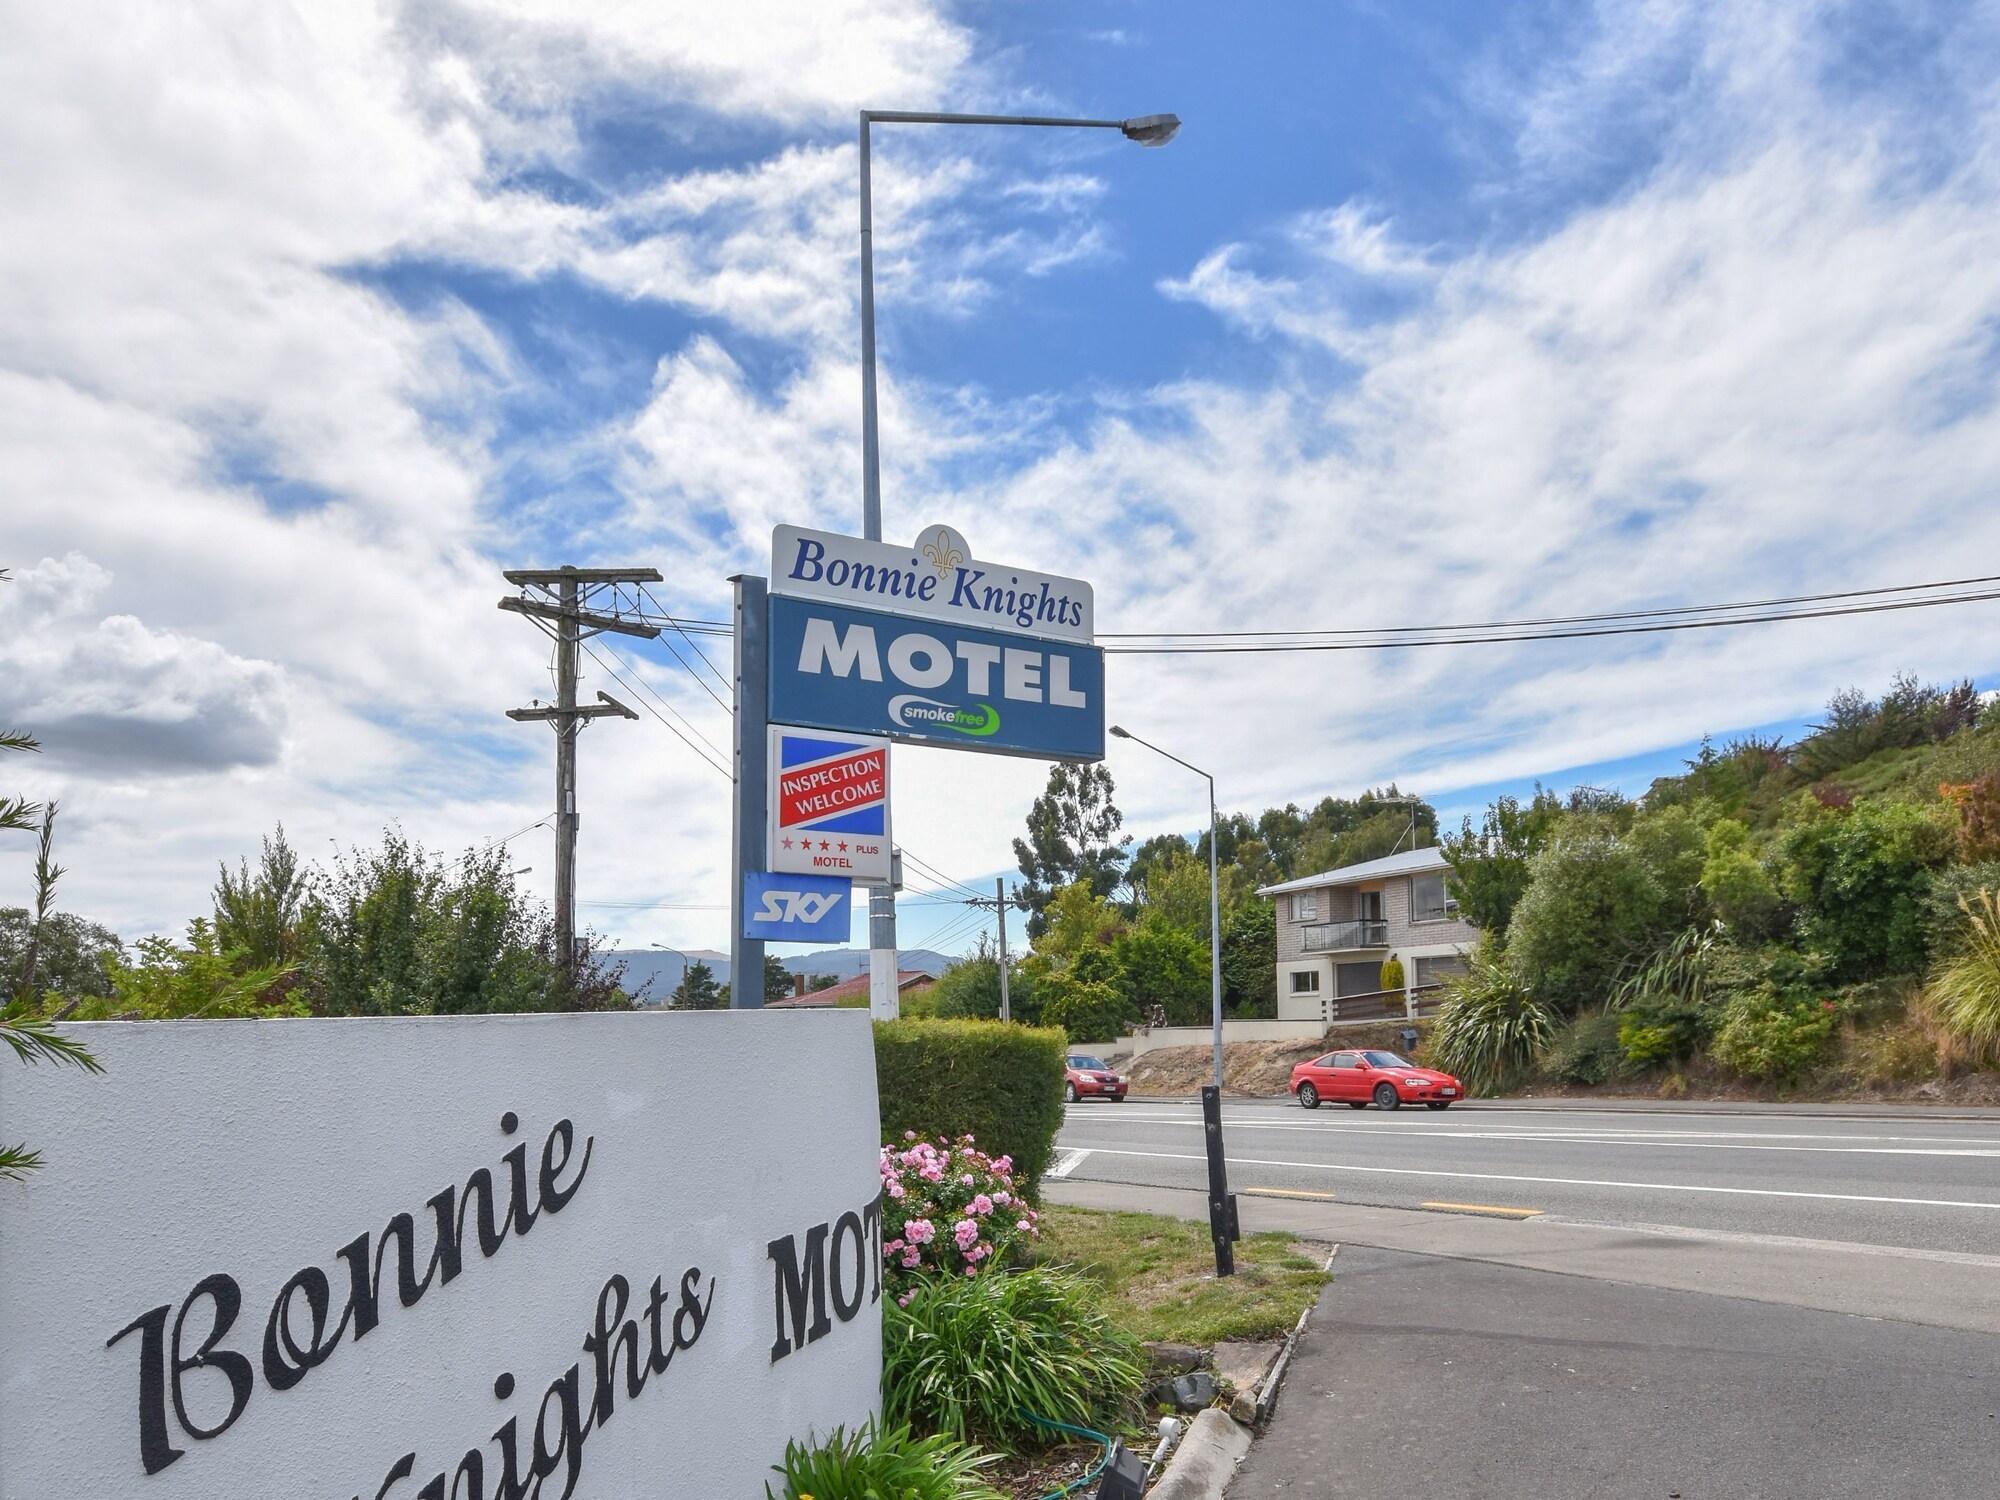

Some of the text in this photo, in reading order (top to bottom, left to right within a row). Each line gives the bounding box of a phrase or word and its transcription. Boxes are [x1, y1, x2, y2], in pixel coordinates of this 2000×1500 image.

[788, 537, 1083, 629] Bonnie Knights
[797, 617, 1087, 709] MOTEL
[904, 706, 985, 726] smokefree
[782, 756, 881, 796] INSPECTION
[795, 778, 882, 815] WELCOME
[813, 856, 853, 868] MOTEL
[856, 844, 879, 855] PLUS
[752, 890, 843, 924] SKY
[106, 1111, 593, 1475] Bonnie
[350, 1266, 716, 1500] nights
